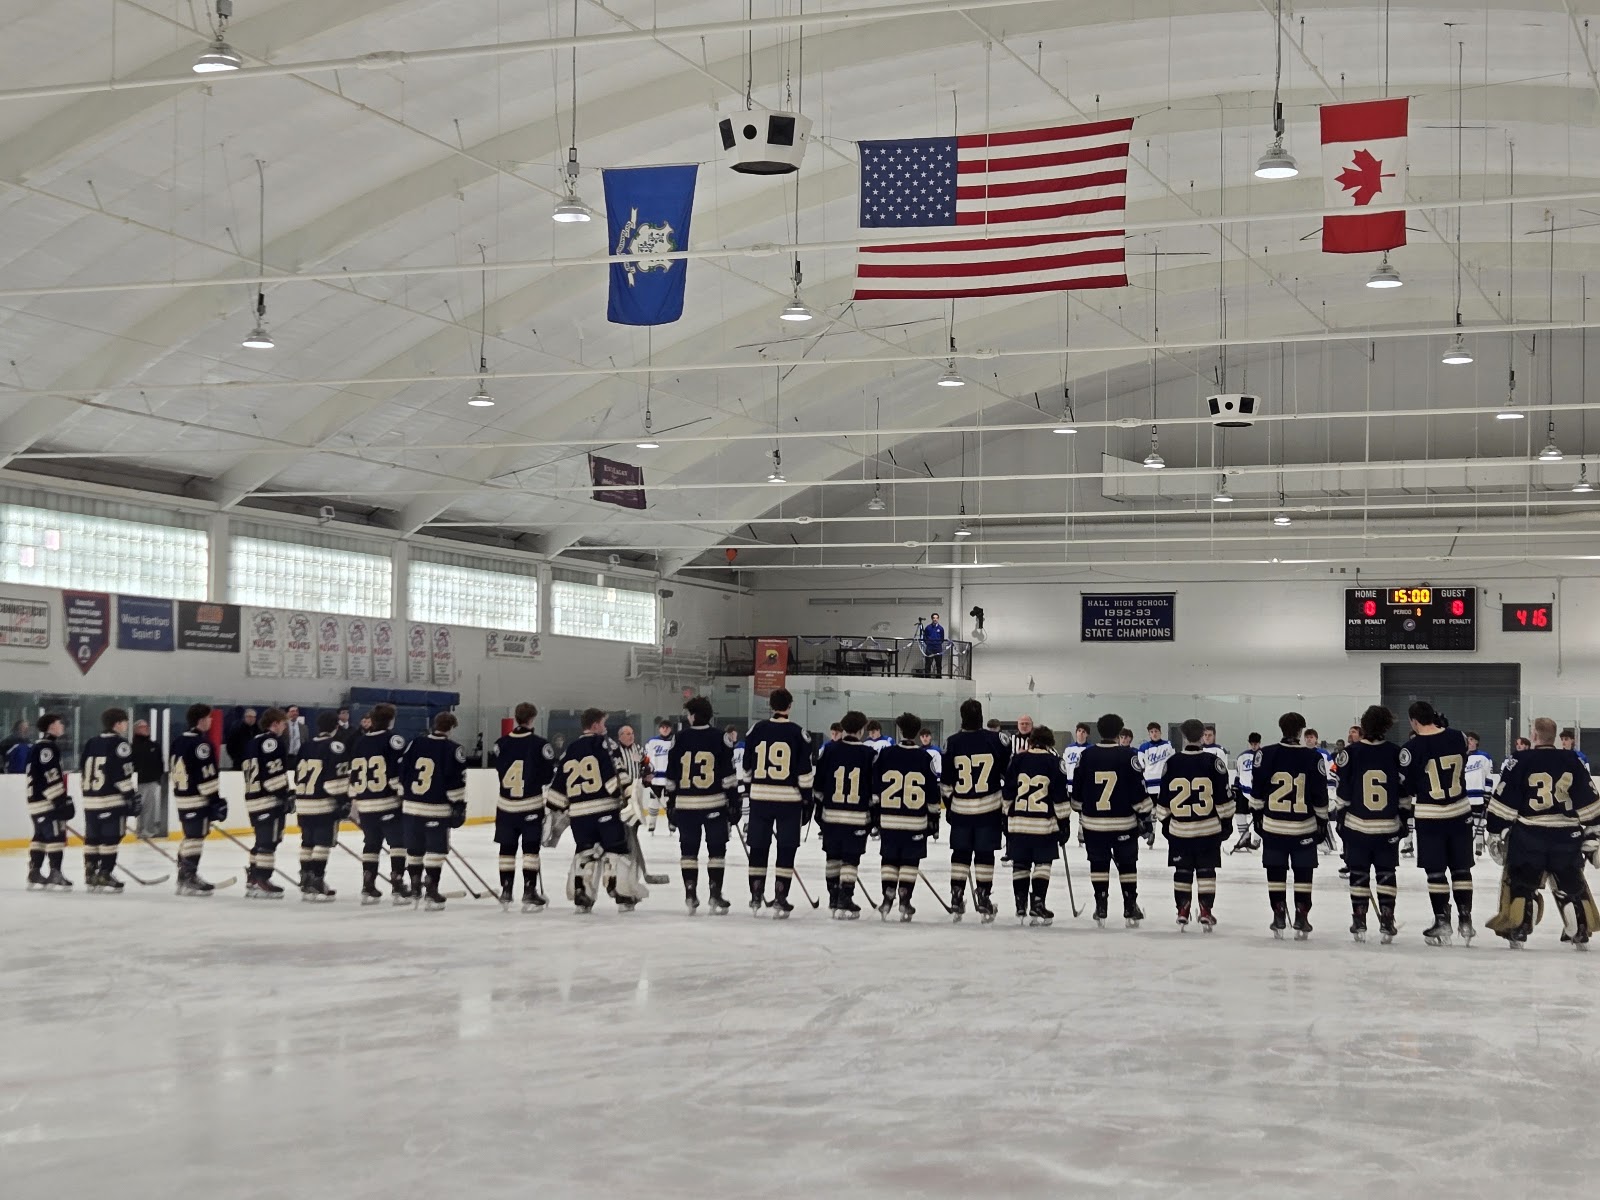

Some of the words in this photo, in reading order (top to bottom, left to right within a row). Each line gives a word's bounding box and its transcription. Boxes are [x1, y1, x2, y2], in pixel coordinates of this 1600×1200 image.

[1136, 599, 1169, 607] SCHOOL
[1355, 590, 1377, 598] HOME
[1364, 600, 1376, 616] 0
[1394, 589, 1430, 603] 15:00
[1441, 589, 1466, 597] GUEST
[1452, 599, 1464, 616] 0
[121, 613, 140, 624] West
[141, 616, 170, 627] Hartford
[1094, 618, 1112, 626] ICE
[1116, 618, 1160, 626] HOCKEY
[1104, 609, 1151, 617] 1992-93
[1085, 628, 1113, 638] STATE
[1117, 628, 1171, 638] CHAMPIONS
[83, 756, 107, 791] 15
[296, 758, 323, 795] 27
[350, 755, 387, 794] 33
[410, 757, 435, 795] 3
[503, 760, 525, 797] 4
[563, 755, 602, 798] 29
[680, 751, 715, 790] 13
[754, 741, 790, 780] 19
[954, 753, 994, 794] 37
[1425, 754, 1463, 800] 17
[832, 766, 860, 804] 11
[880, 769, 926, 810] 26
[1014, 772, 1050, 813] 22
[1094, 771, 1117, 811] 7
[1169, 777, 1213, 817] 23
[1268, 771, 1308, 813] 21
[1362, 769, 1388, 812] 6
